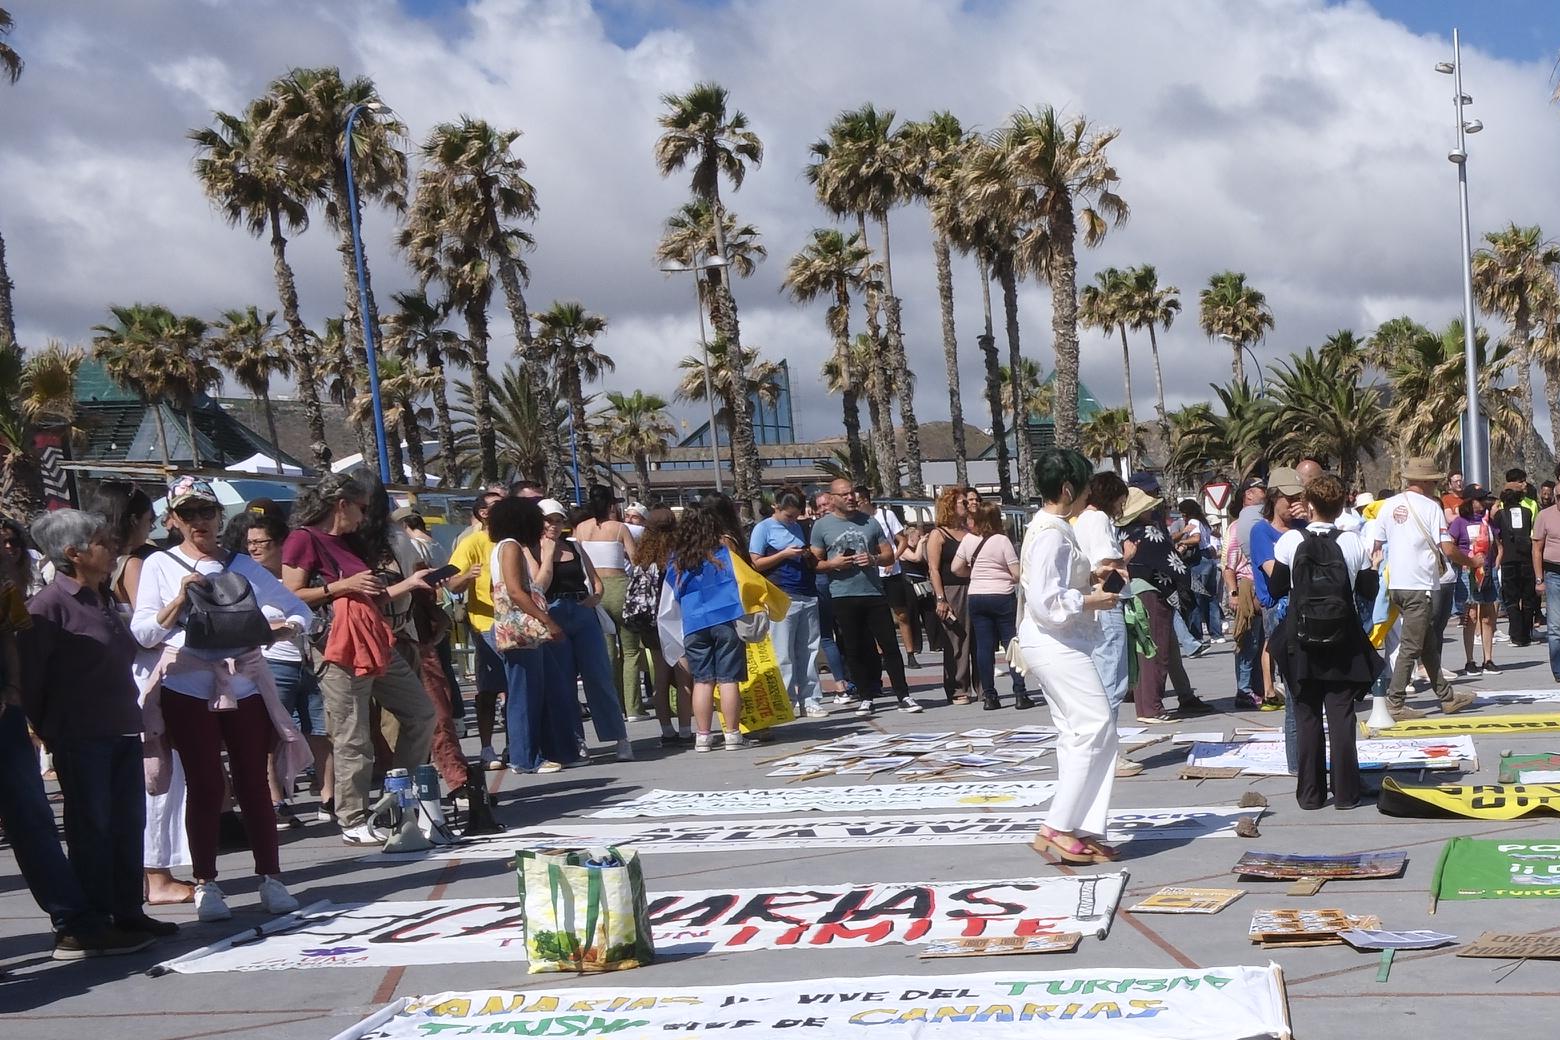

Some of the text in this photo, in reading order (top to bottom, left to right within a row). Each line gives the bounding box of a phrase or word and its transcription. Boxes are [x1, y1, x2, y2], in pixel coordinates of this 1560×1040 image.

[797, 990, 891, 1005] VIVE
[899, 987, 981, 1002] DEL
[771, 1015, 829, 1029] DE
[848, 999, 1169, 1026] CANARIAS
